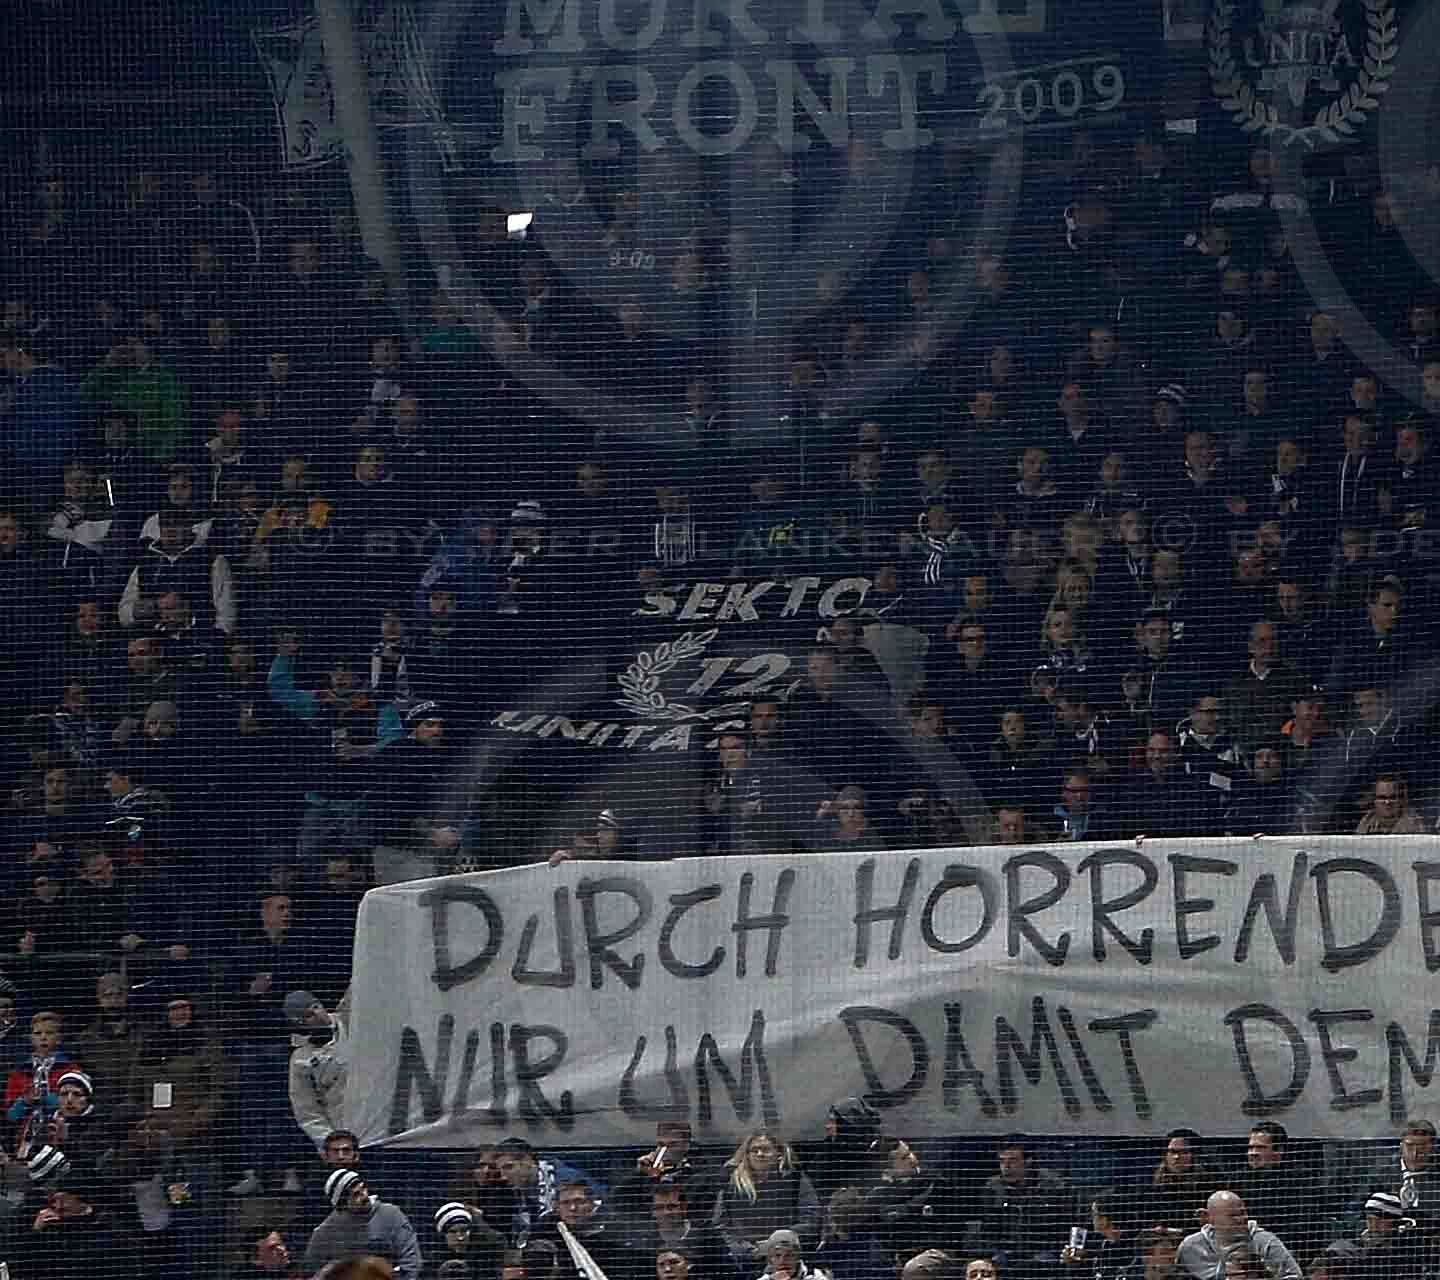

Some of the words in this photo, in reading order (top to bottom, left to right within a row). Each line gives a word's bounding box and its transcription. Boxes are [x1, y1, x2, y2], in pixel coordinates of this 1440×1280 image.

[973, 63, 1127, 133] 2009
[1243, 29, 1357, 68] UNITA
[489, 55, 948, 166] FRONT
[418, 870, 793, 992] DURCH
[402, 1013, 576, 1132] NUR
[616, 1007, 780, 1124] UM
[837, 996, 1160, 1123] DAMIT
